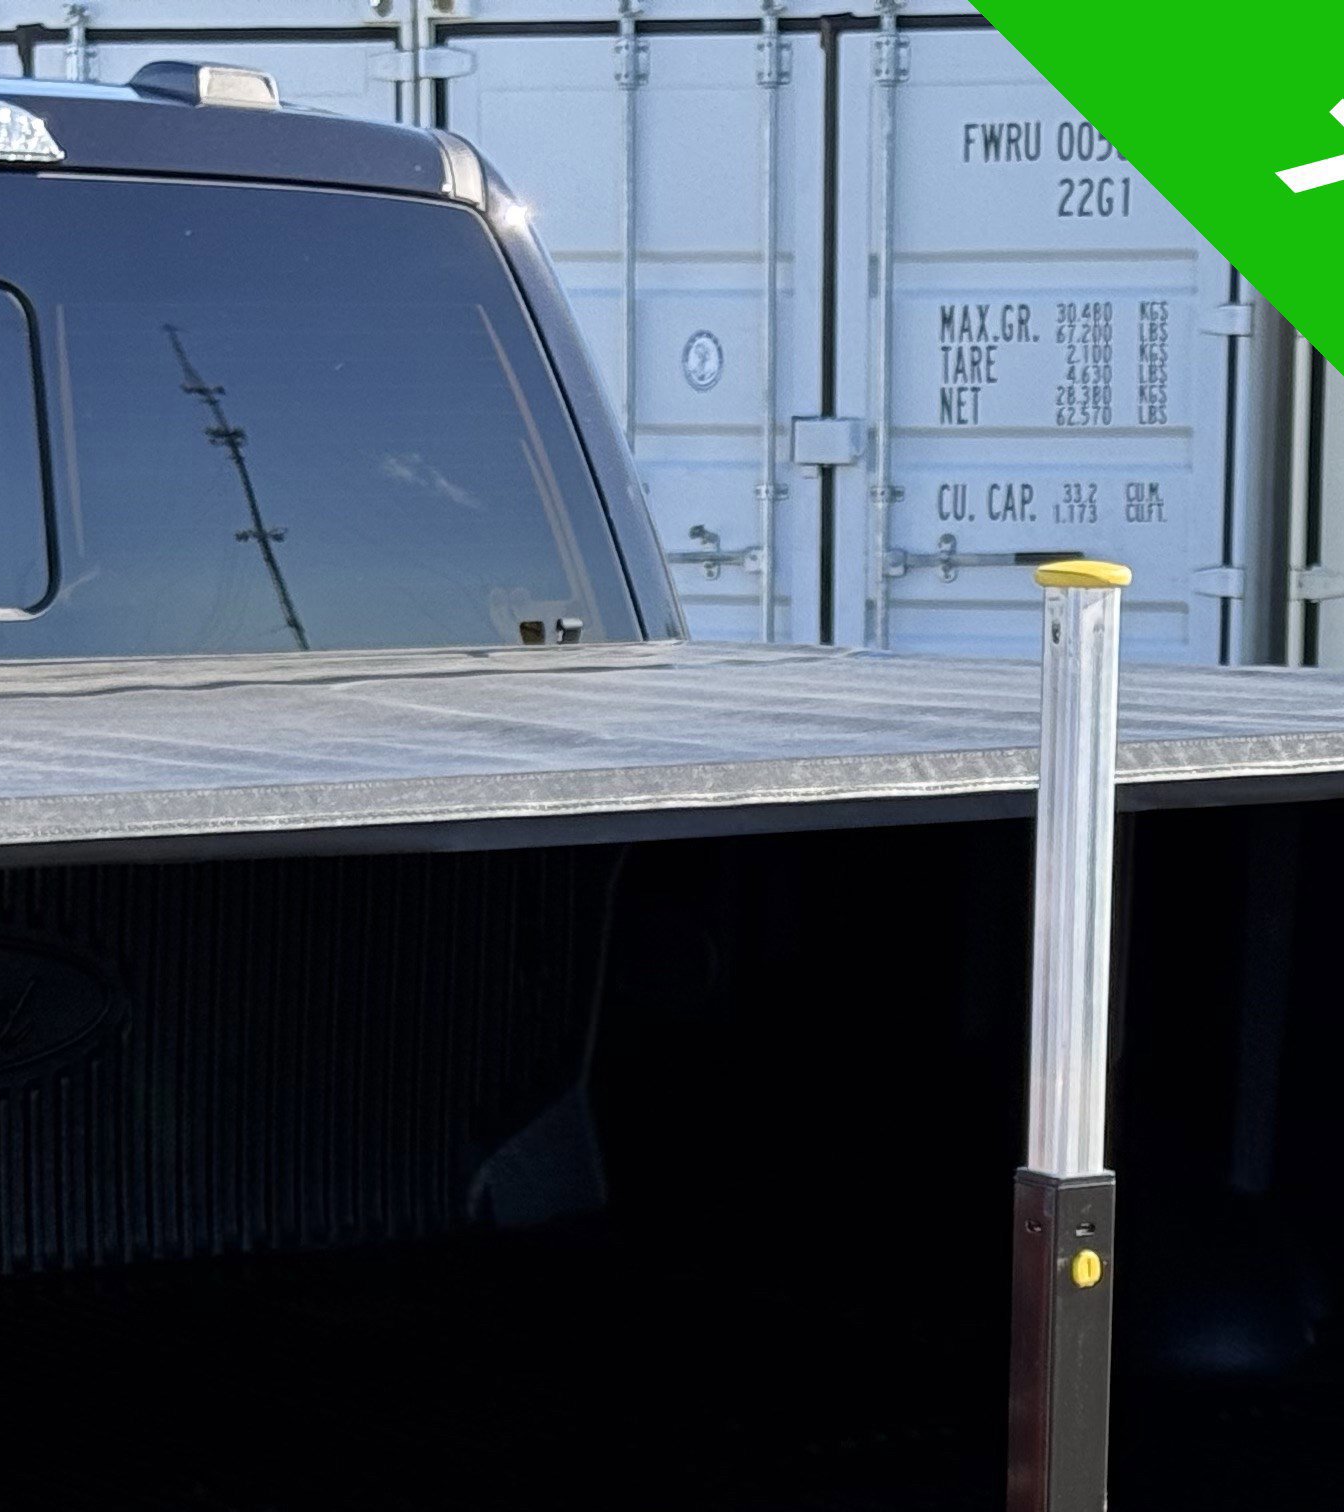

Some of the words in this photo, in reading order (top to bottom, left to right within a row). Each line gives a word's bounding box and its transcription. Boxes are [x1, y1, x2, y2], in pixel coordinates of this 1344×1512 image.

[963, 122, 1041, 162] FWRU
[1057, 177, 1130, 217] 22G1
[1138, 301, 1169, 321] KGS
[1138, 322, 1168, 342] LBS
[941, 345, 998, 384] TARE
[1138, 344, 1168, 363] KGS
[1138, 364, 1168, 384] LBS
[940, 386, 981, 425] NET
[1138, 385, 1168, 404] KGS
[1138, 405, 1168, 425] LBS
[988, 483, 1036, 522] CAP.
